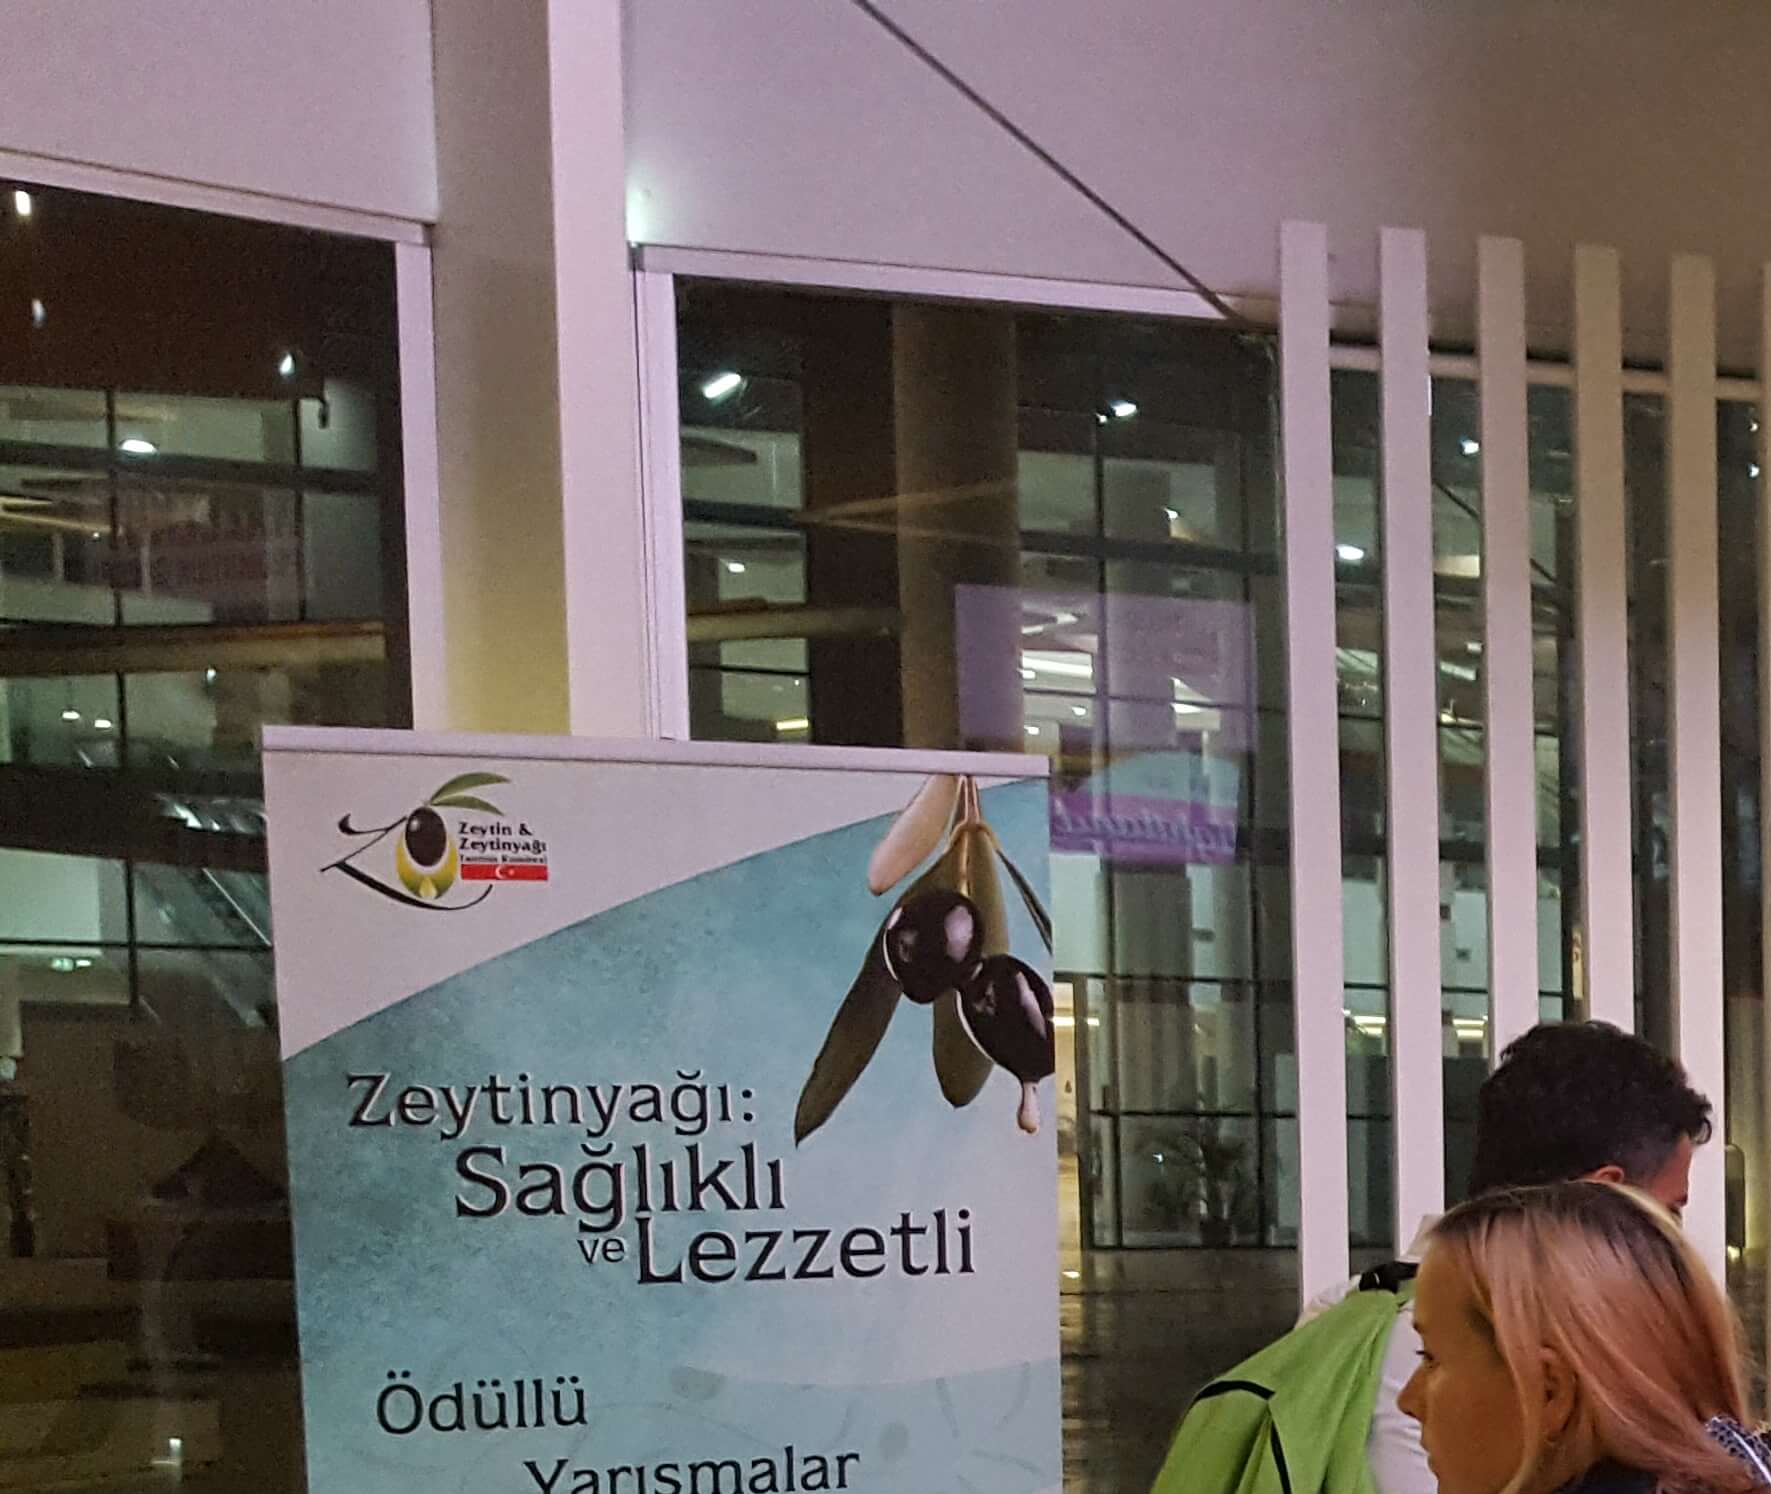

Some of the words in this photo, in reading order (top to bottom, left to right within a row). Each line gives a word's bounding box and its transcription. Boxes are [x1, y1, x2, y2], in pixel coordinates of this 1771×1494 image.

[458, 821, 512, 837] Zeytin
[519, 823, 533, 836] &
[458, 838, 547, 855] Zeytinyağı
[346, 1070, 756, 1138] Zeytinyağı:
[454, 1141, 787, 1235] Sağlıklı
[577, 1236, 626, 1266] ve
[637, 1209, 976, 1286] Lezzetli
[376, 1370, 589, 1436] Ödüllü
